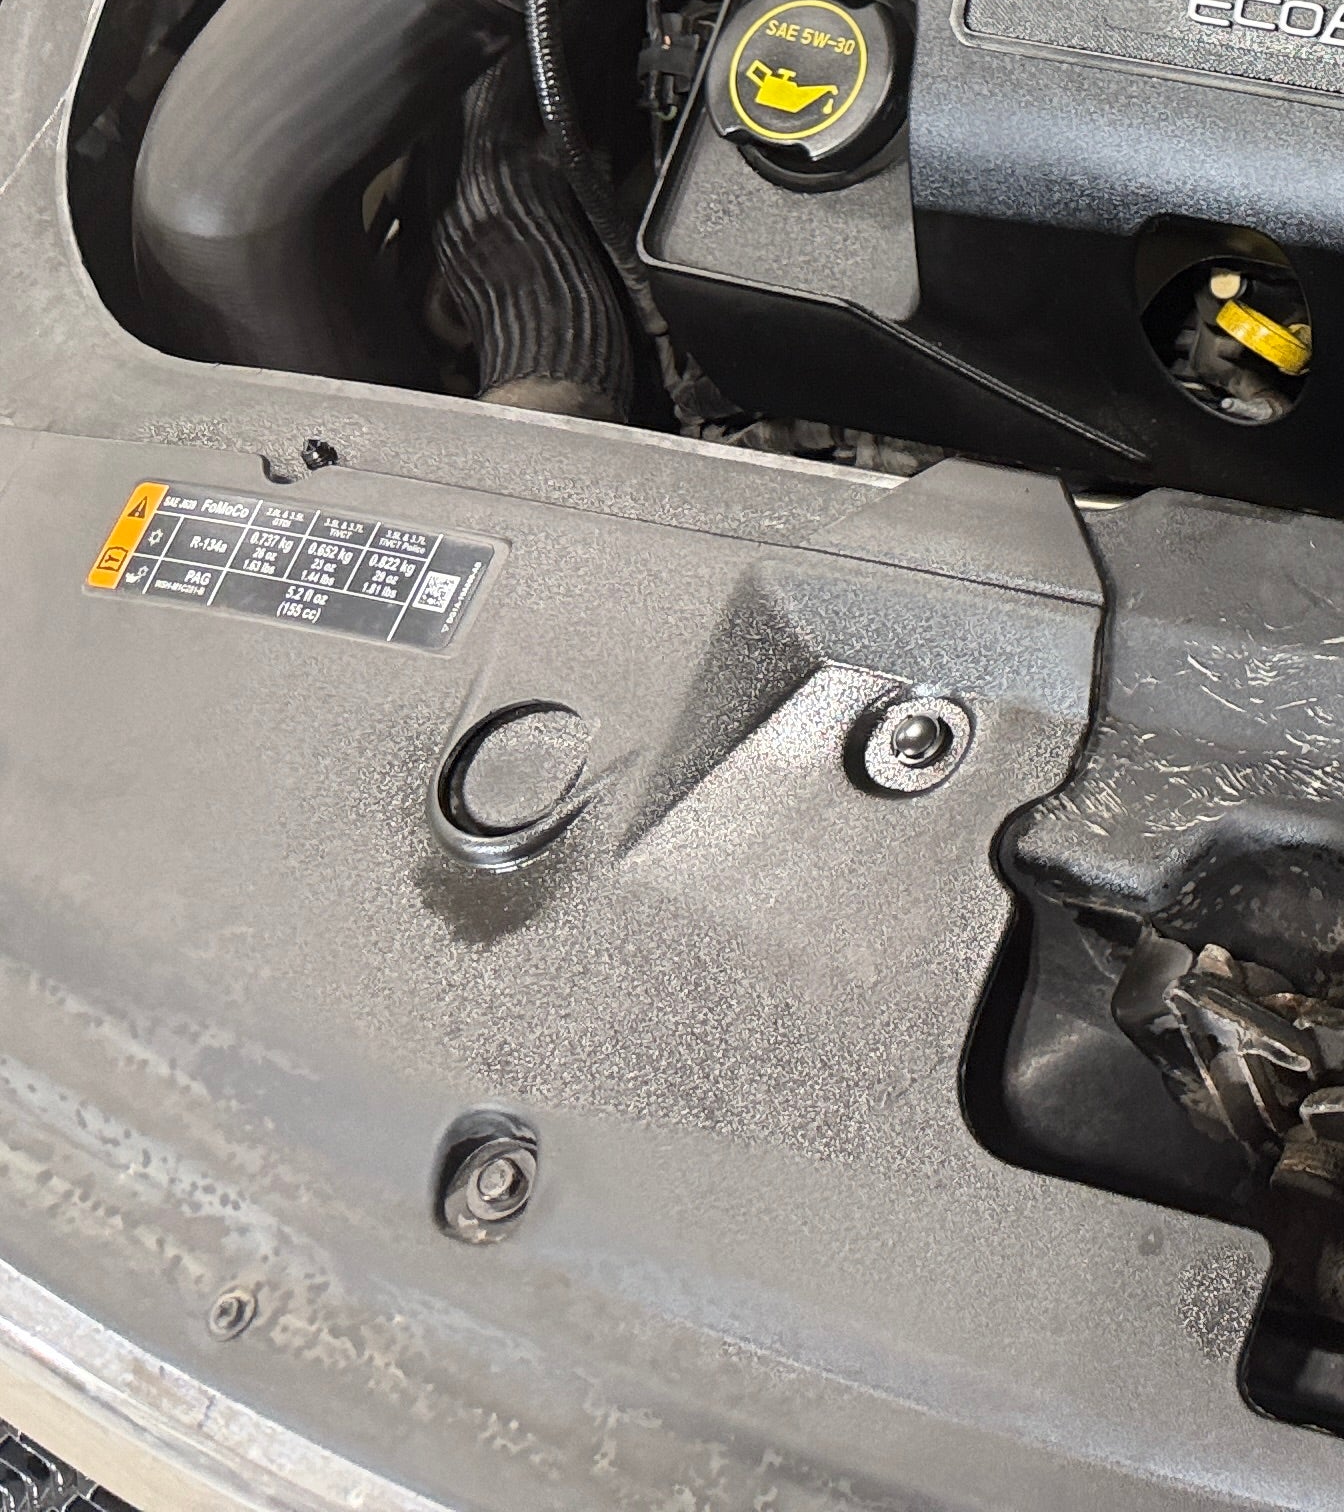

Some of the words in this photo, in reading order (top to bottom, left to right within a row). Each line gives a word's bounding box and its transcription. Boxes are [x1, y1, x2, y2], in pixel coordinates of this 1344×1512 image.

[765, 19, 801, 42] SAE
[800, 28, 857, 56] 5W-30
[200, 498, 250, 519] FoMoCo
[189, 535, 228, 554] R-134a
[250, 531, 280, 548] 0.737
[278, 533, 295, 554] kg
[265, 552, 278, 562] oz
[307, 541, 339, 559] 0.652
[337, 547, 354, 565] kg
[261, 562, 276, 575] lbs
[324, 562, 338, 573] oz
[369, 553, 400, 571] 0.822
[400, 559, 417, 578] kg
[184, 569, 211, 586] PAG
[300, 569, 320, 583] 1.44
[320, 573, 336, 587] lbs
[386, 574, 400, 585] oz
[285, 585, 305, 601] 5.2
[313, 594, 330, 606] oz
[381, 585, 398, 599] lbs
[276, 600, 302, 618] (155
[301, 608, 322, 625] cc)
